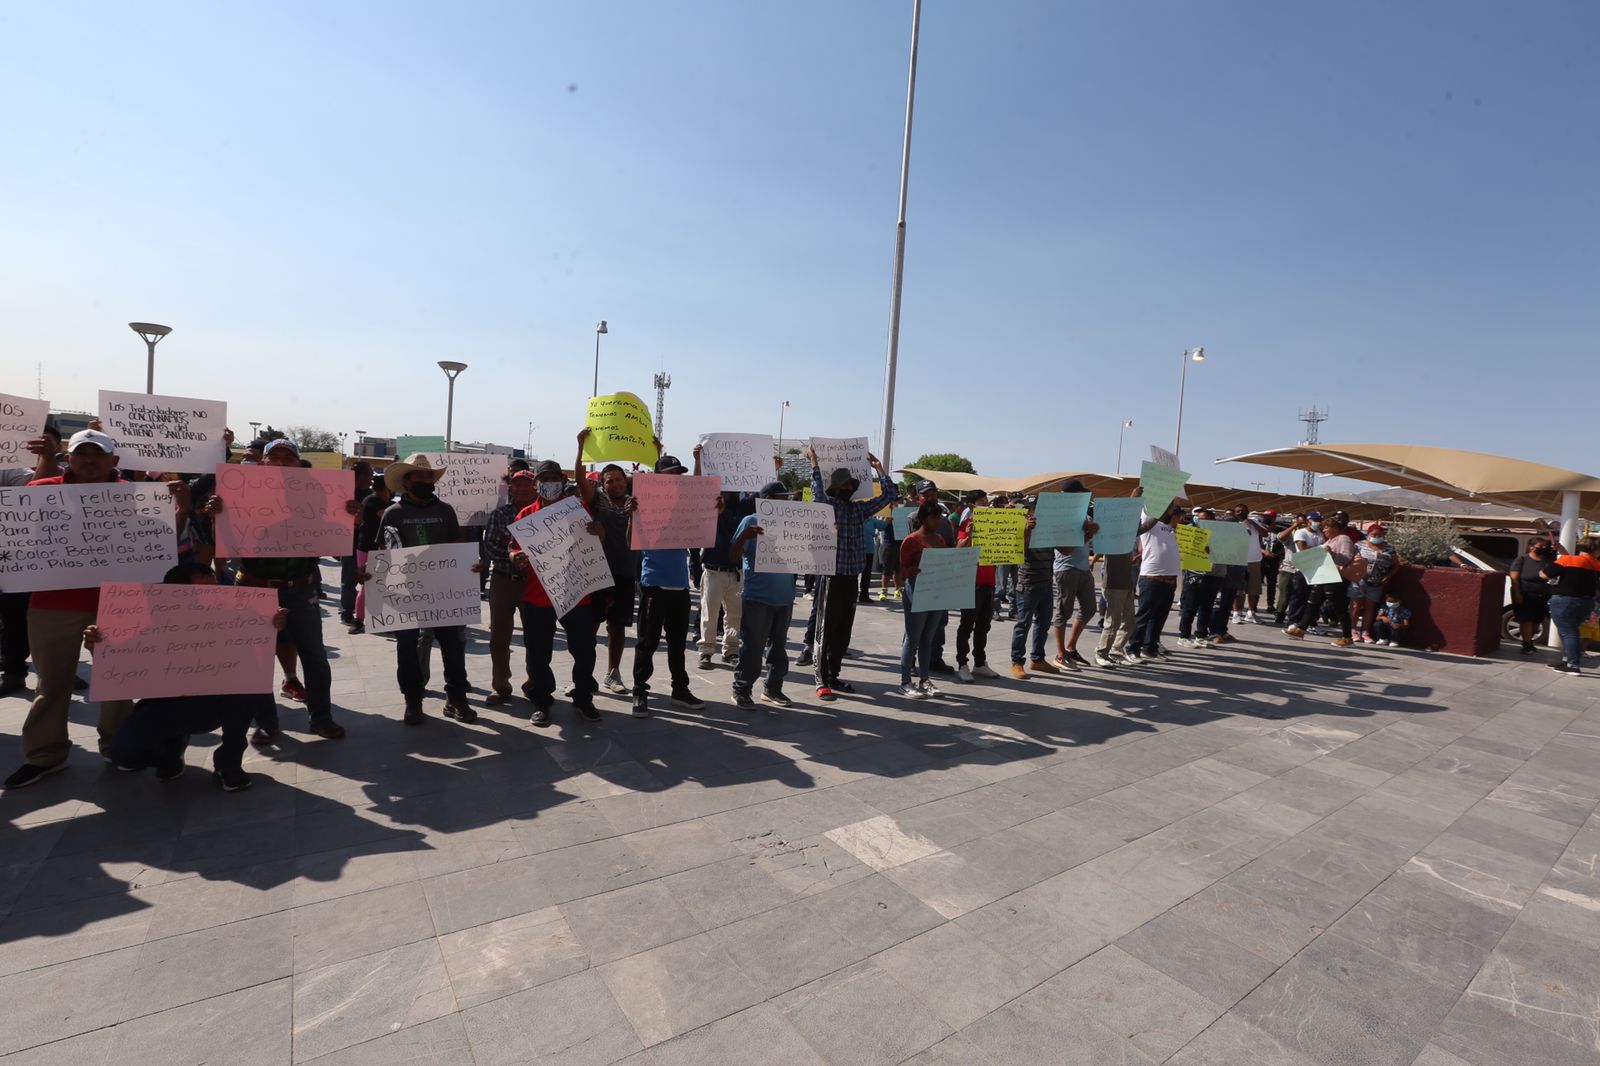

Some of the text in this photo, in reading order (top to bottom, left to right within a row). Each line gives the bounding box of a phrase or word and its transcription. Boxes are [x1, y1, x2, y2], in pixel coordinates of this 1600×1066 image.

[0, 403, 24, 416] OS
[110, 402, 124, 411] Los
[110, 418, 125, 428] Los
[448, 478, 460, 487] de
[1, 489, 174, 506] En el relleno hay
[487, 486, 498, 496] el
[0, 506, 161, 522] muchos Factores
[760, 500, 826, 518] Queremos
[41, 523, 70, 534] que
[761, 518, 777, 532] que
[82, 532, 112, 544] Por
[124, 526, 174, 542] ejemplo
[783, 530, 832, 540] Presidente
[66, 544, 135, 558] Botellas
[144, 542, 165, 552] de
[758, 540, 806, 553] Queremos
[48, 558, 84, 569] Pilas
[90, 557, 110, 567] de
[116, 552, 173, 563] celulares
[374, 554, 457, 575] Socosema
[536, 559, 550, 573] de
[376, 579, 424, 592] Somos
[384, 588, 480, 606] Trabajadores
[372, 606, 480, 628] NO DELINCUENTES
[163, 658, 241, 678] trabajar
